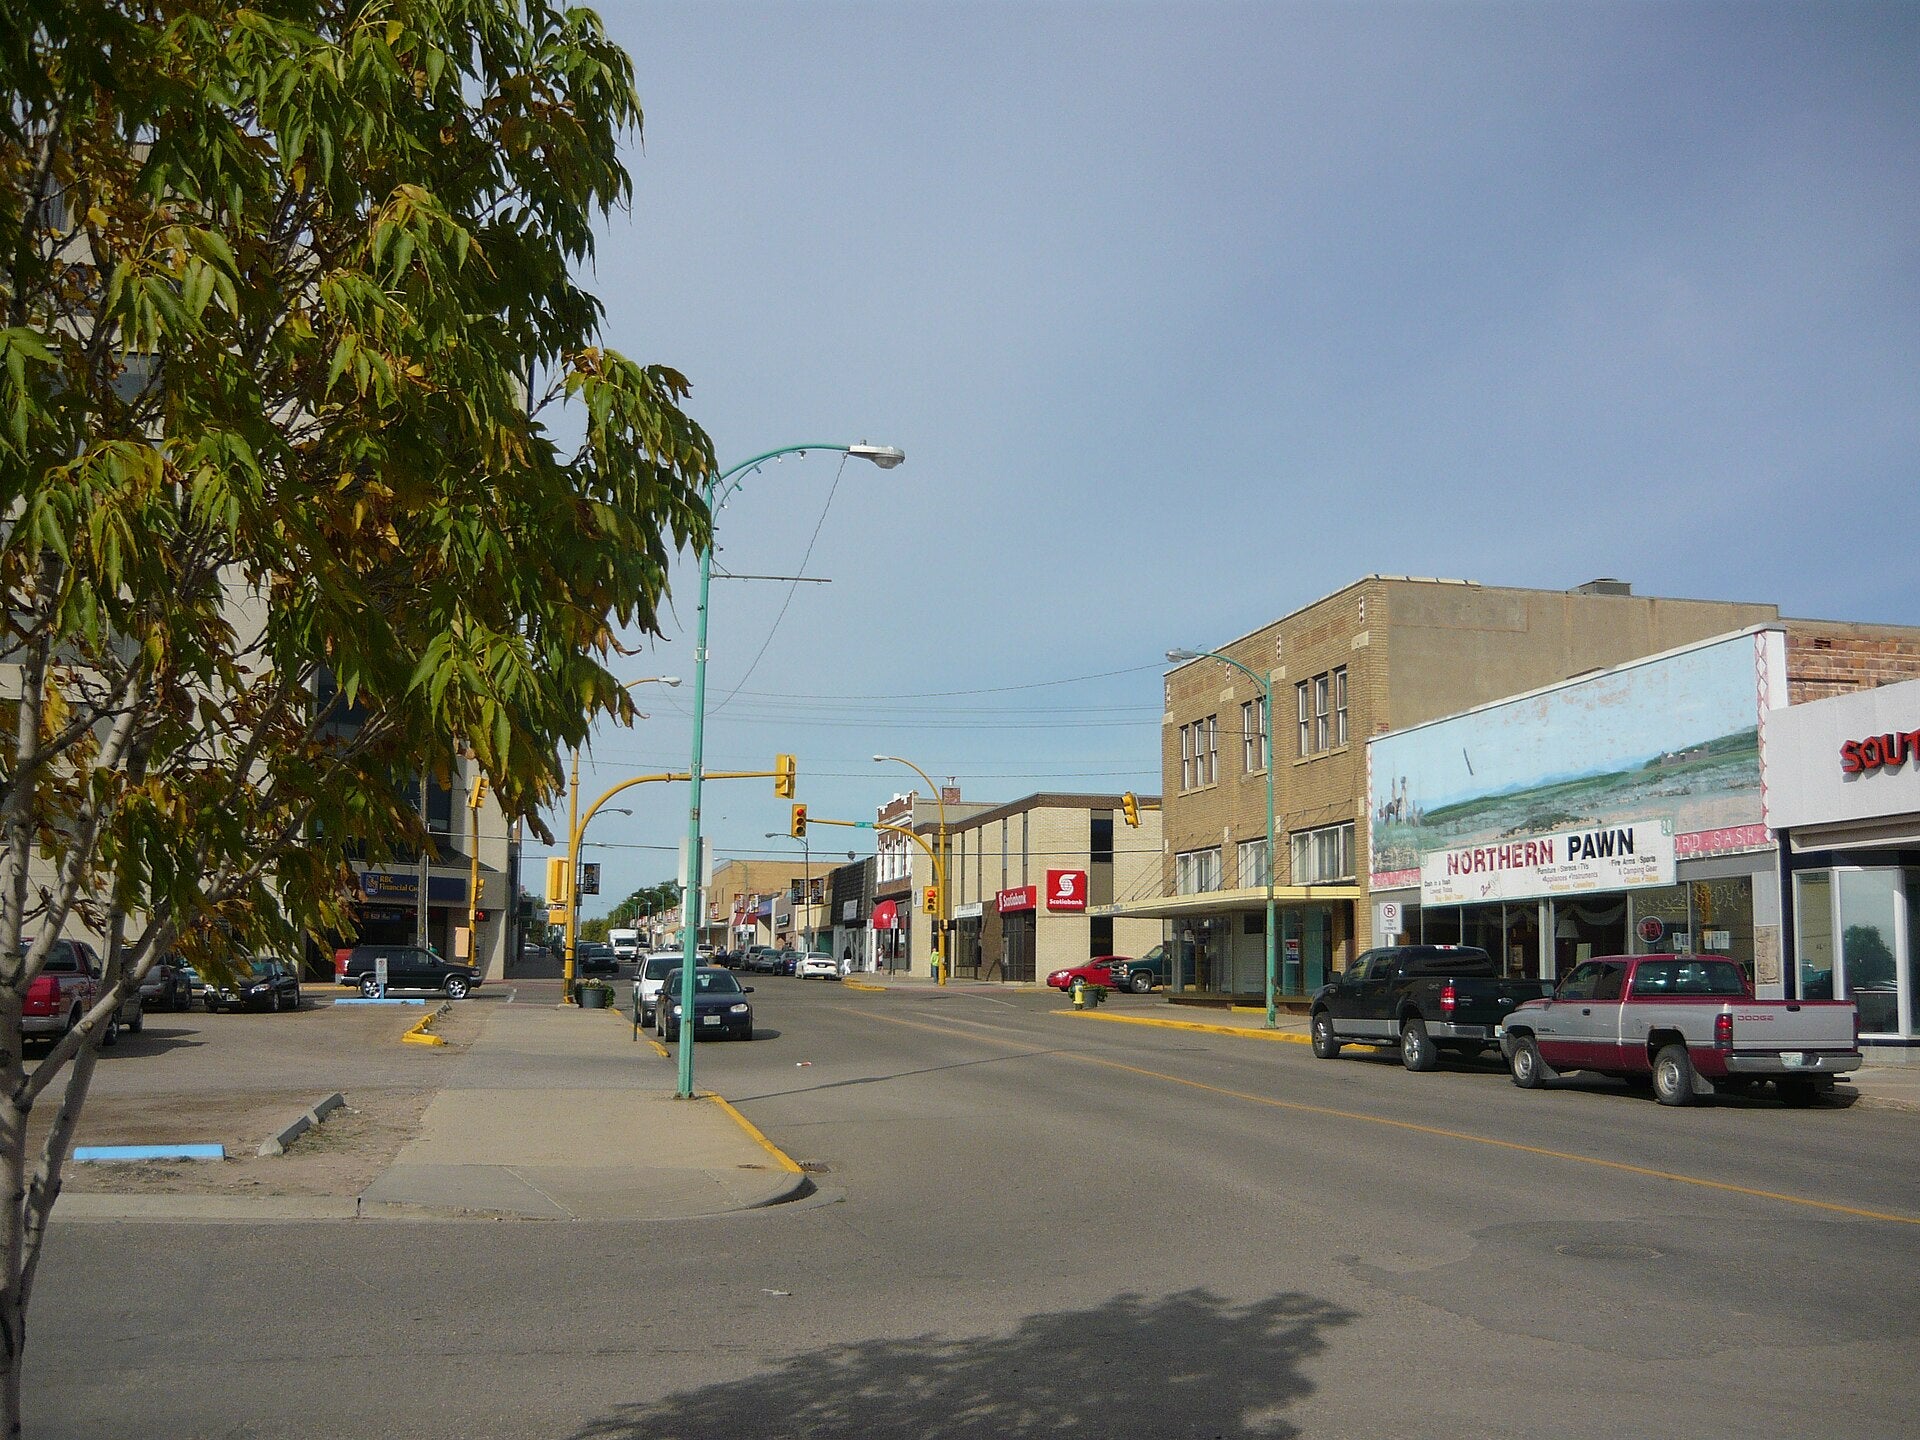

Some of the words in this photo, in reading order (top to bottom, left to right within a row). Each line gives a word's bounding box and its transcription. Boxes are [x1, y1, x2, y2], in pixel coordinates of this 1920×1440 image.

[1447, 839, 1553, 875] NORTHERN
[1568, 828, 1633, 861] PAWN
[1640, 855, 1656, 866] Sports
[379, 875, 393, 883] RBC
[379, 884, 408, 892] Financial
[1003, 890, 1027, 908] Scotiabank
